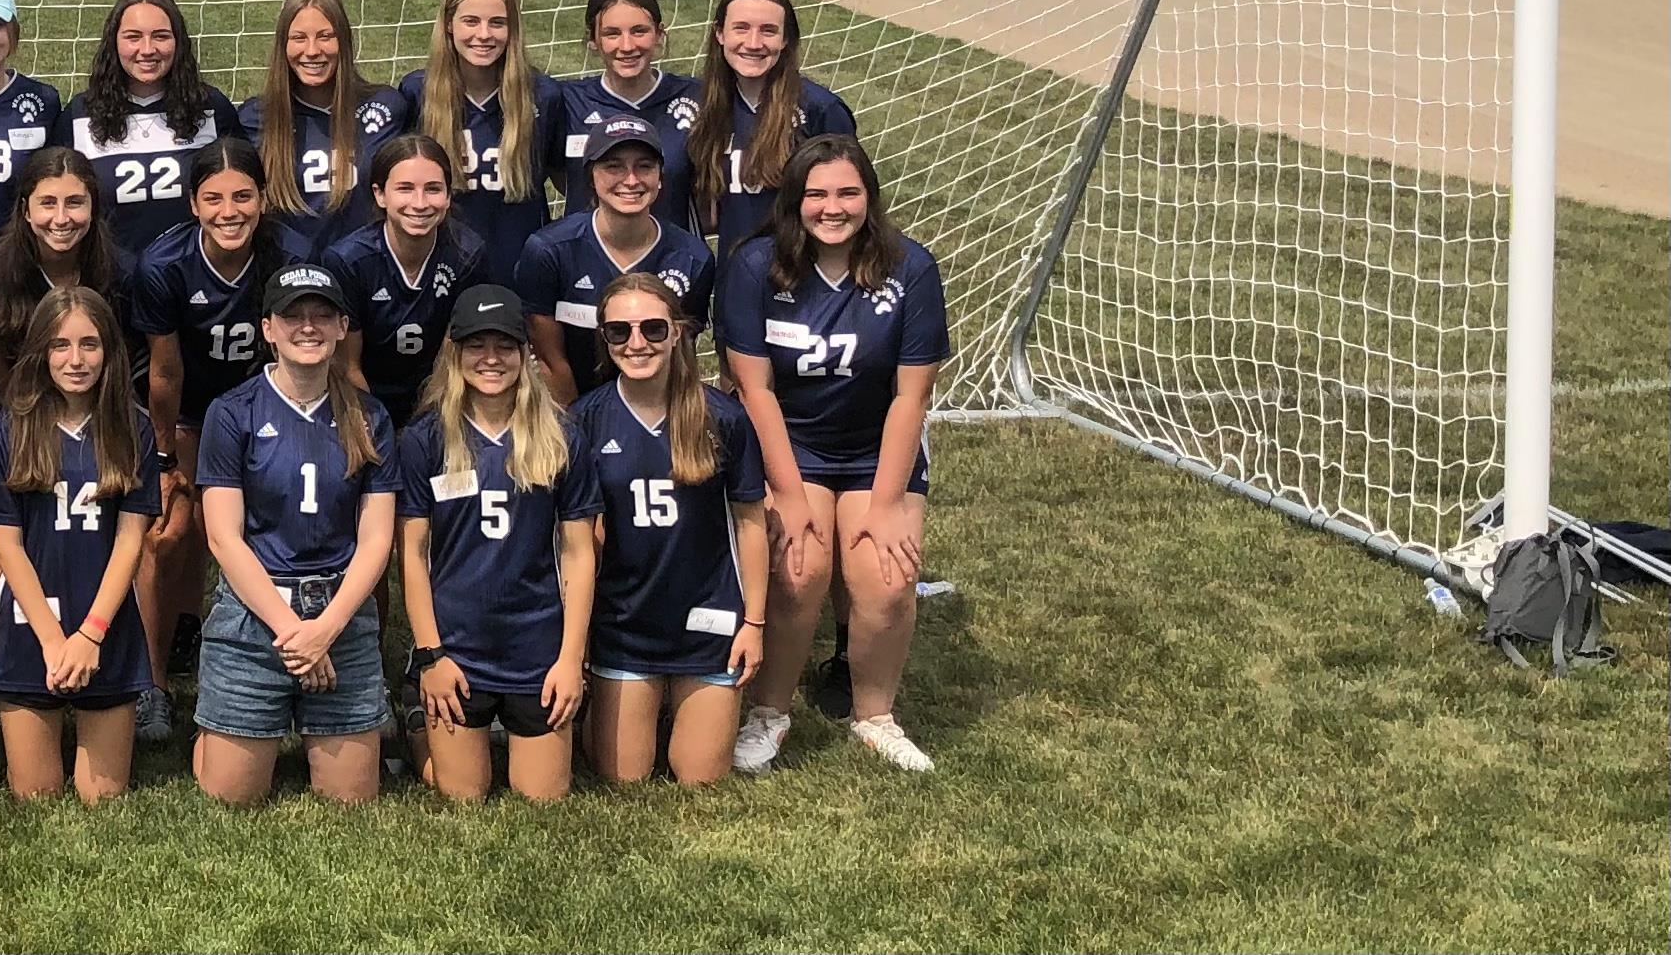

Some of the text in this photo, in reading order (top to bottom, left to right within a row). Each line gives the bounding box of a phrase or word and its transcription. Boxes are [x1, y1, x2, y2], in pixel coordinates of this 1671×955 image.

[114, 156, 183, 204] 22
[279, 268, 307, 284] CEDAR
[885, 276, 906, 298] EAUGA
[208, 322, 256, 362] 12
[396, 323, 424, 355] 6
[796, 333, 857, 377] 27
[53, 480, 102, 531] 14
[299, 462, 318, 514] 1
[629, 478, 679, 527] 15
[480, 489, 511, 540] 5
